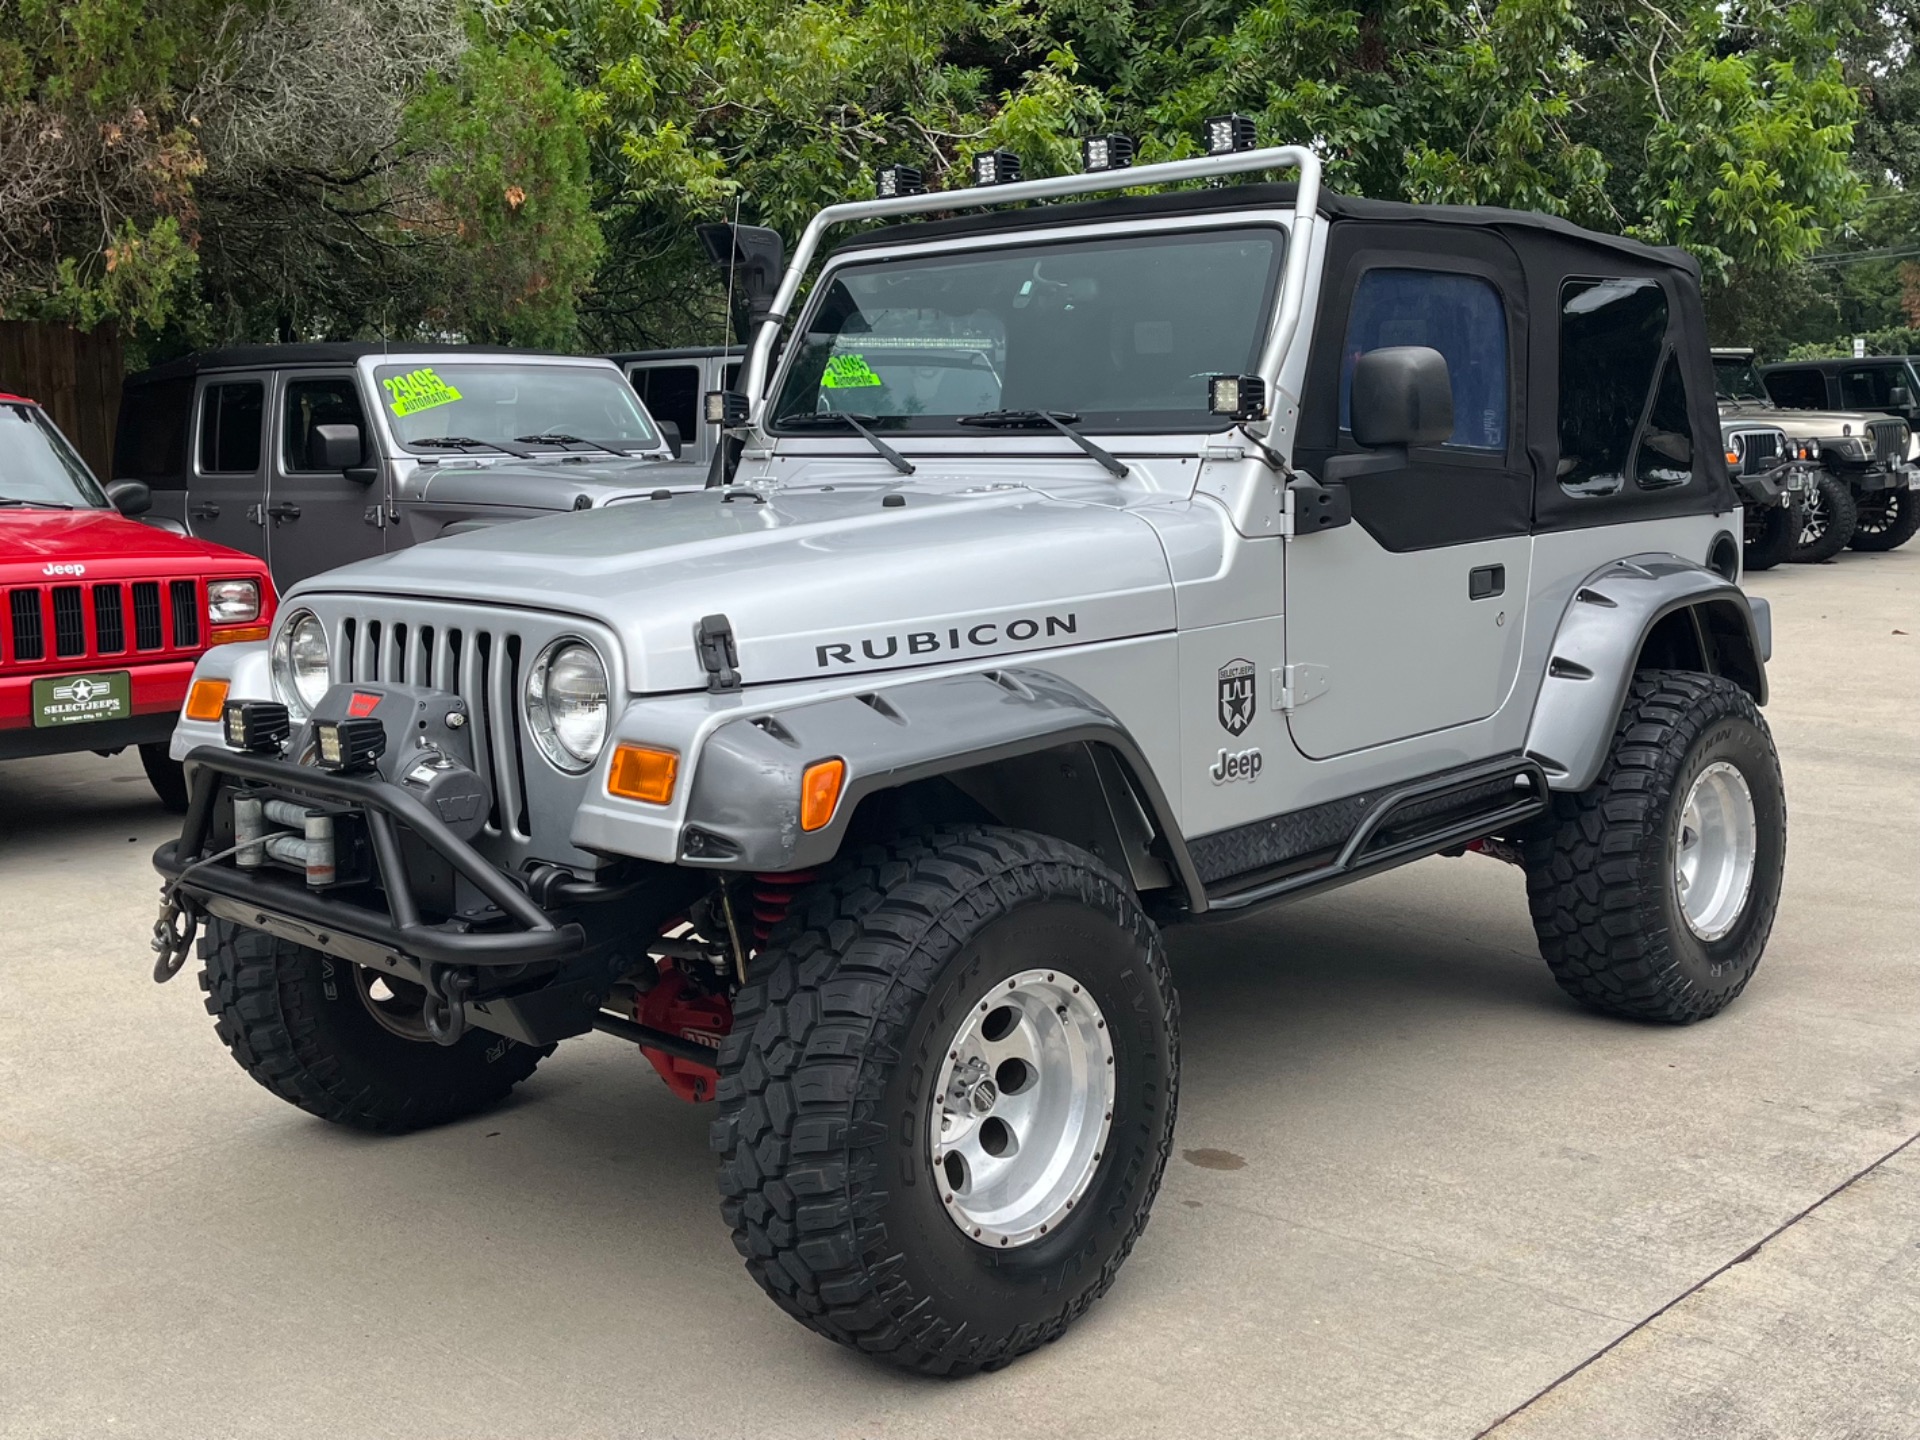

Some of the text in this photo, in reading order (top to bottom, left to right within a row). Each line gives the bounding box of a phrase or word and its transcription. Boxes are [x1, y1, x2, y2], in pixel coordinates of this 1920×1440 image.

[383, 368, 447, 402] 29495
[403, 390, 452, 412] AUTOMATIC
[43, 563, 85, 576] Jeep
[815, 613, 1077, 667] RUBICON
[1211, 749, 1263, 783] Jeep
